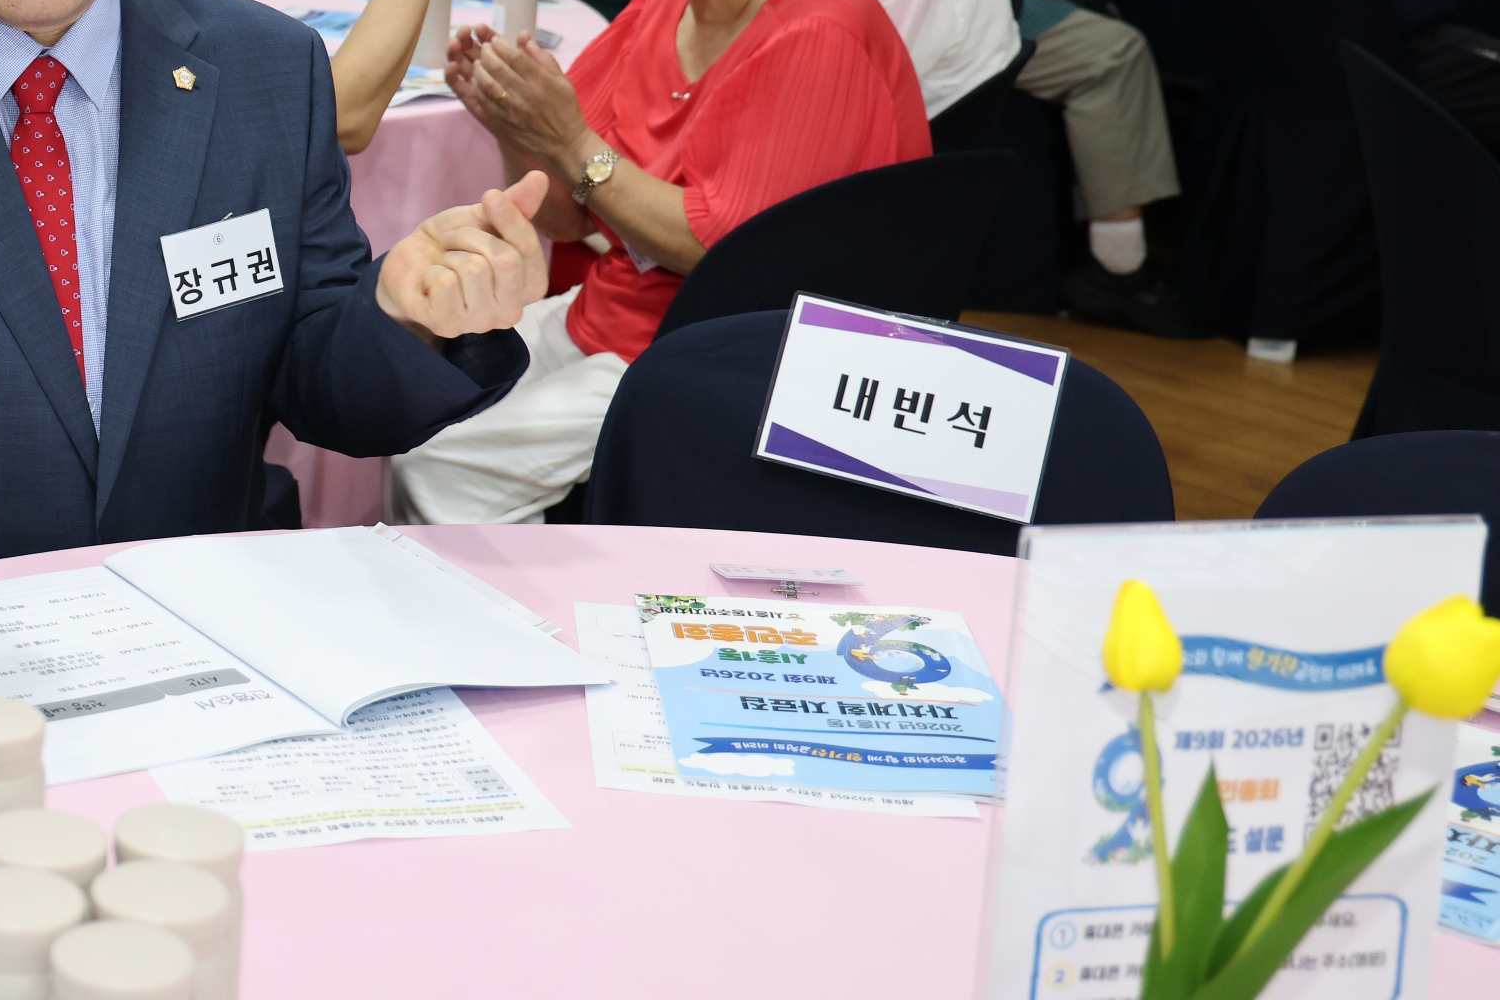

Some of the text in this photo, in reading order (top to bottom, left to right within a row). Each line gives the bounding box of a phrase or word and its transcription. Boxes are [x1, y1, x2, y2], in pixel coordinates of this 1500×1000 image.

[173, 246, 276, 305] 장규권
[832, 373, 993, 450] 내빈석
[68, 611, 96, 621] 17:25
[103, 605, 131, 615] 17:20
[91, 626, 119, 636] 17:20
[126, 620, 154, 630] 16:40
[670, 621, 820, 647] 주민총회
[154, 638, 182, 649] 16:25
[118, 646, 147, 656] 16:40
[716, 647, 808, 665] 시흥1동
[147, 665, 176, 675] 16:25
[184, 658, 211, 668] 16:00
[184, 675, 219, 688] 시간
[698, 668, 838, 685] 제9회 2026년
[71, 699, 107, 712] 진행
[193, 688, 274, 711] 진행순서
[738, 695, 959, 720] 자치계획 자료집
[825, 718, 965, 733] 2026년 시흥1동
[1232, 727, 1305, 749] 2026년
[1216, 777, 1281, 804] 민총회
[829, 793, 874, 803] 2026년
[1245, 824, 1285, 854] 설문
